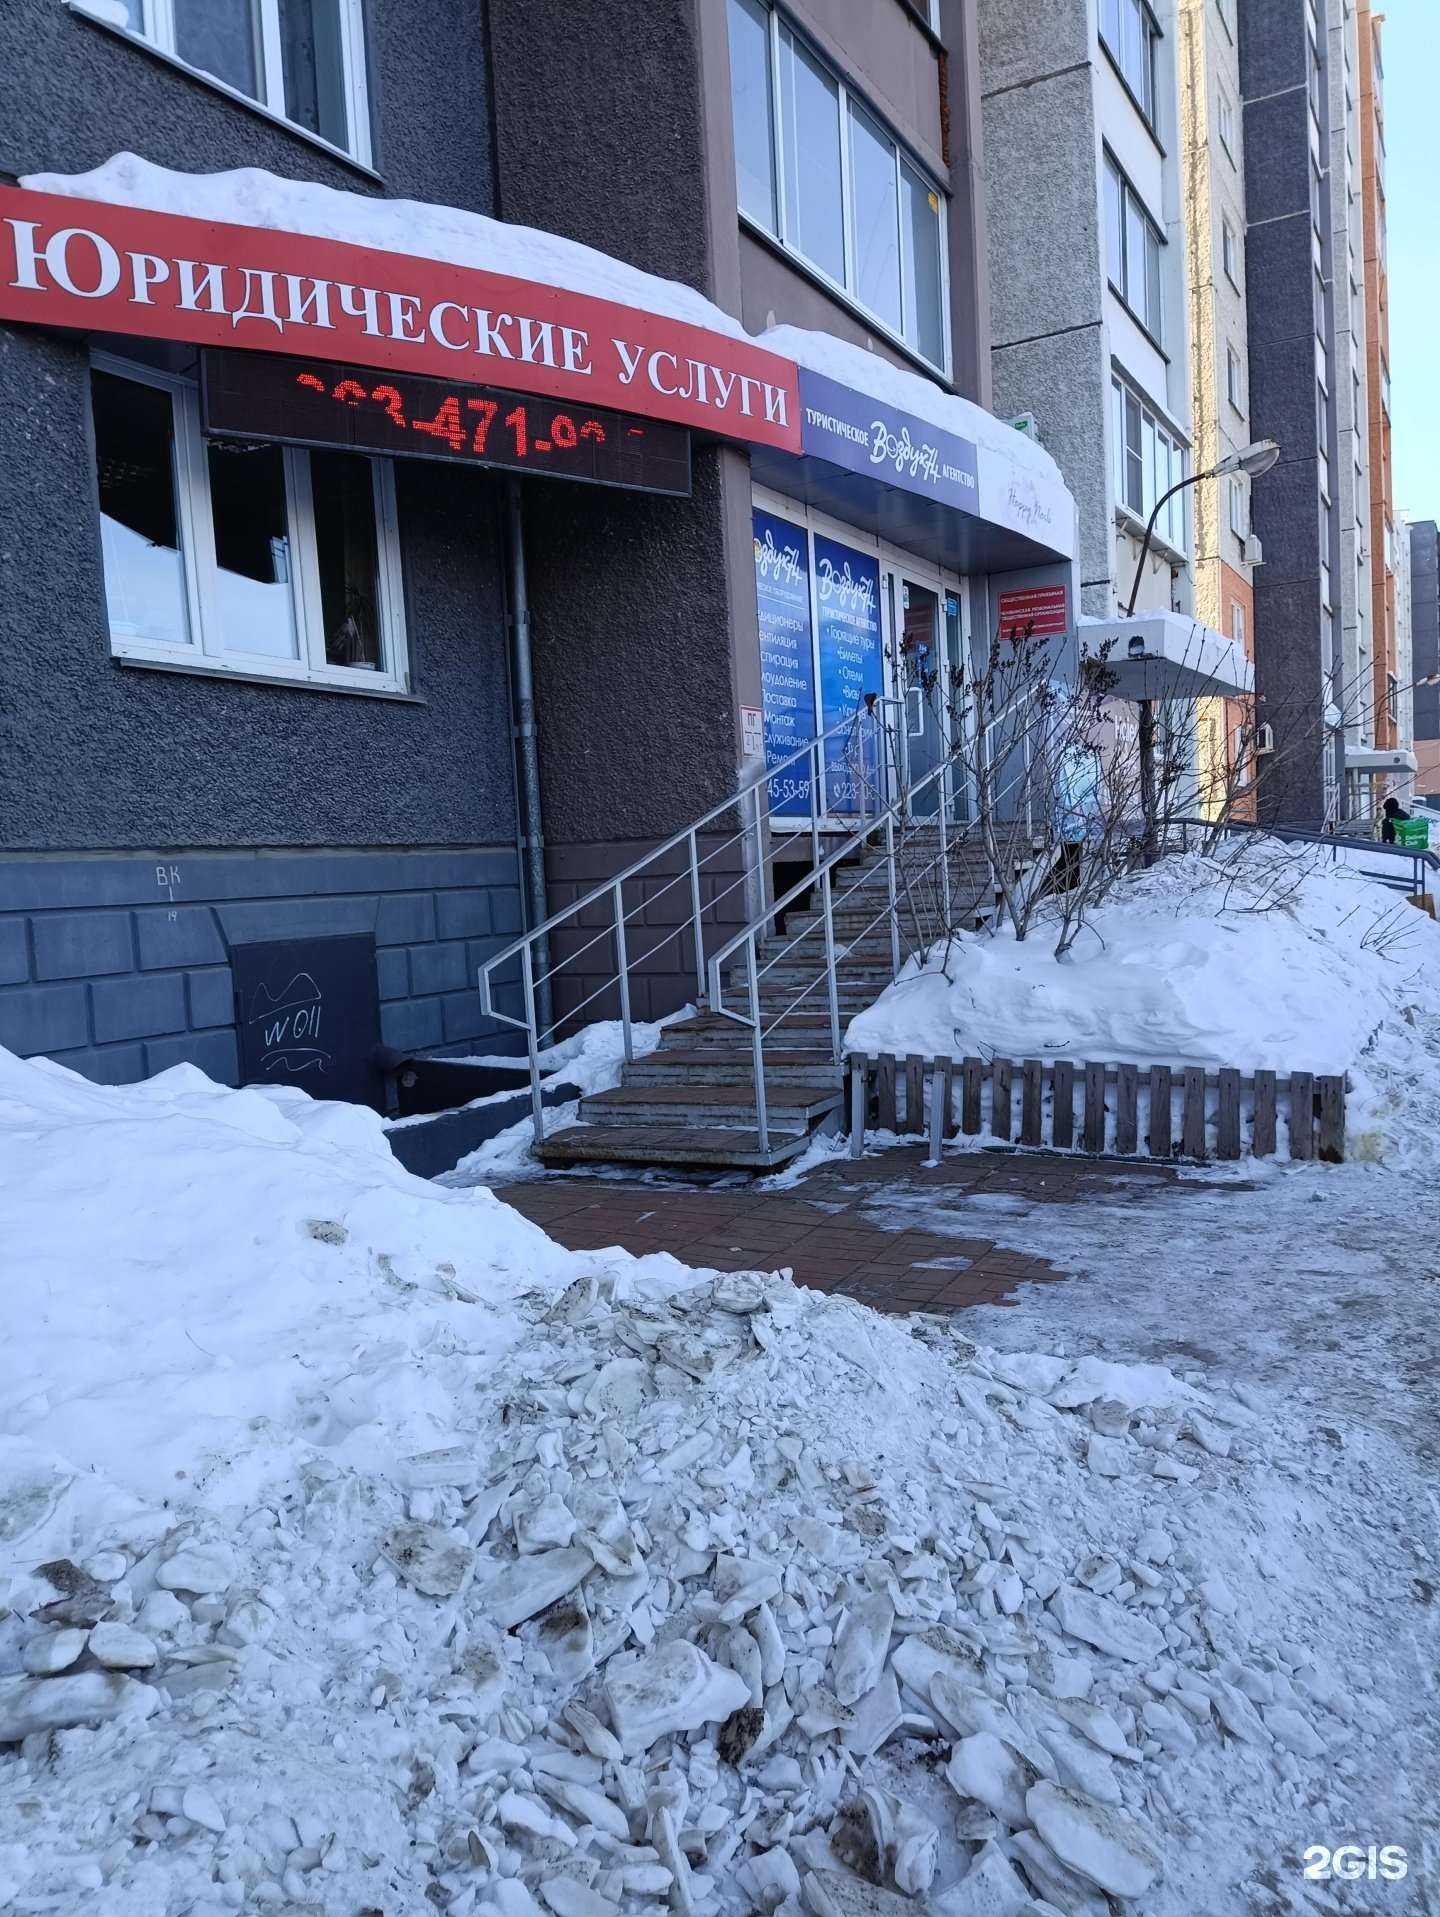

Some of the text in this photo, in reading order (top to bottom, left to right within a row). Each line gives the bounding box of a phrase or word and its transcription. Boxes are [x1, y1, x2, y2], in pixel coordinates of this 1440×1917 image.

[3, 218, 789, 428] ЮРИДИЧЕСКИЕ УСЛУГИ
[806, 407, 869, 447] ТУРИСТИЧЕСКОЕ
[942, 463, 975, 489] АГЕНТСТВО
[753, 529, 802, 586] оздух74
[758, 630, 798, 650] ентиляция
[760, 651, 799, 670] спирация
